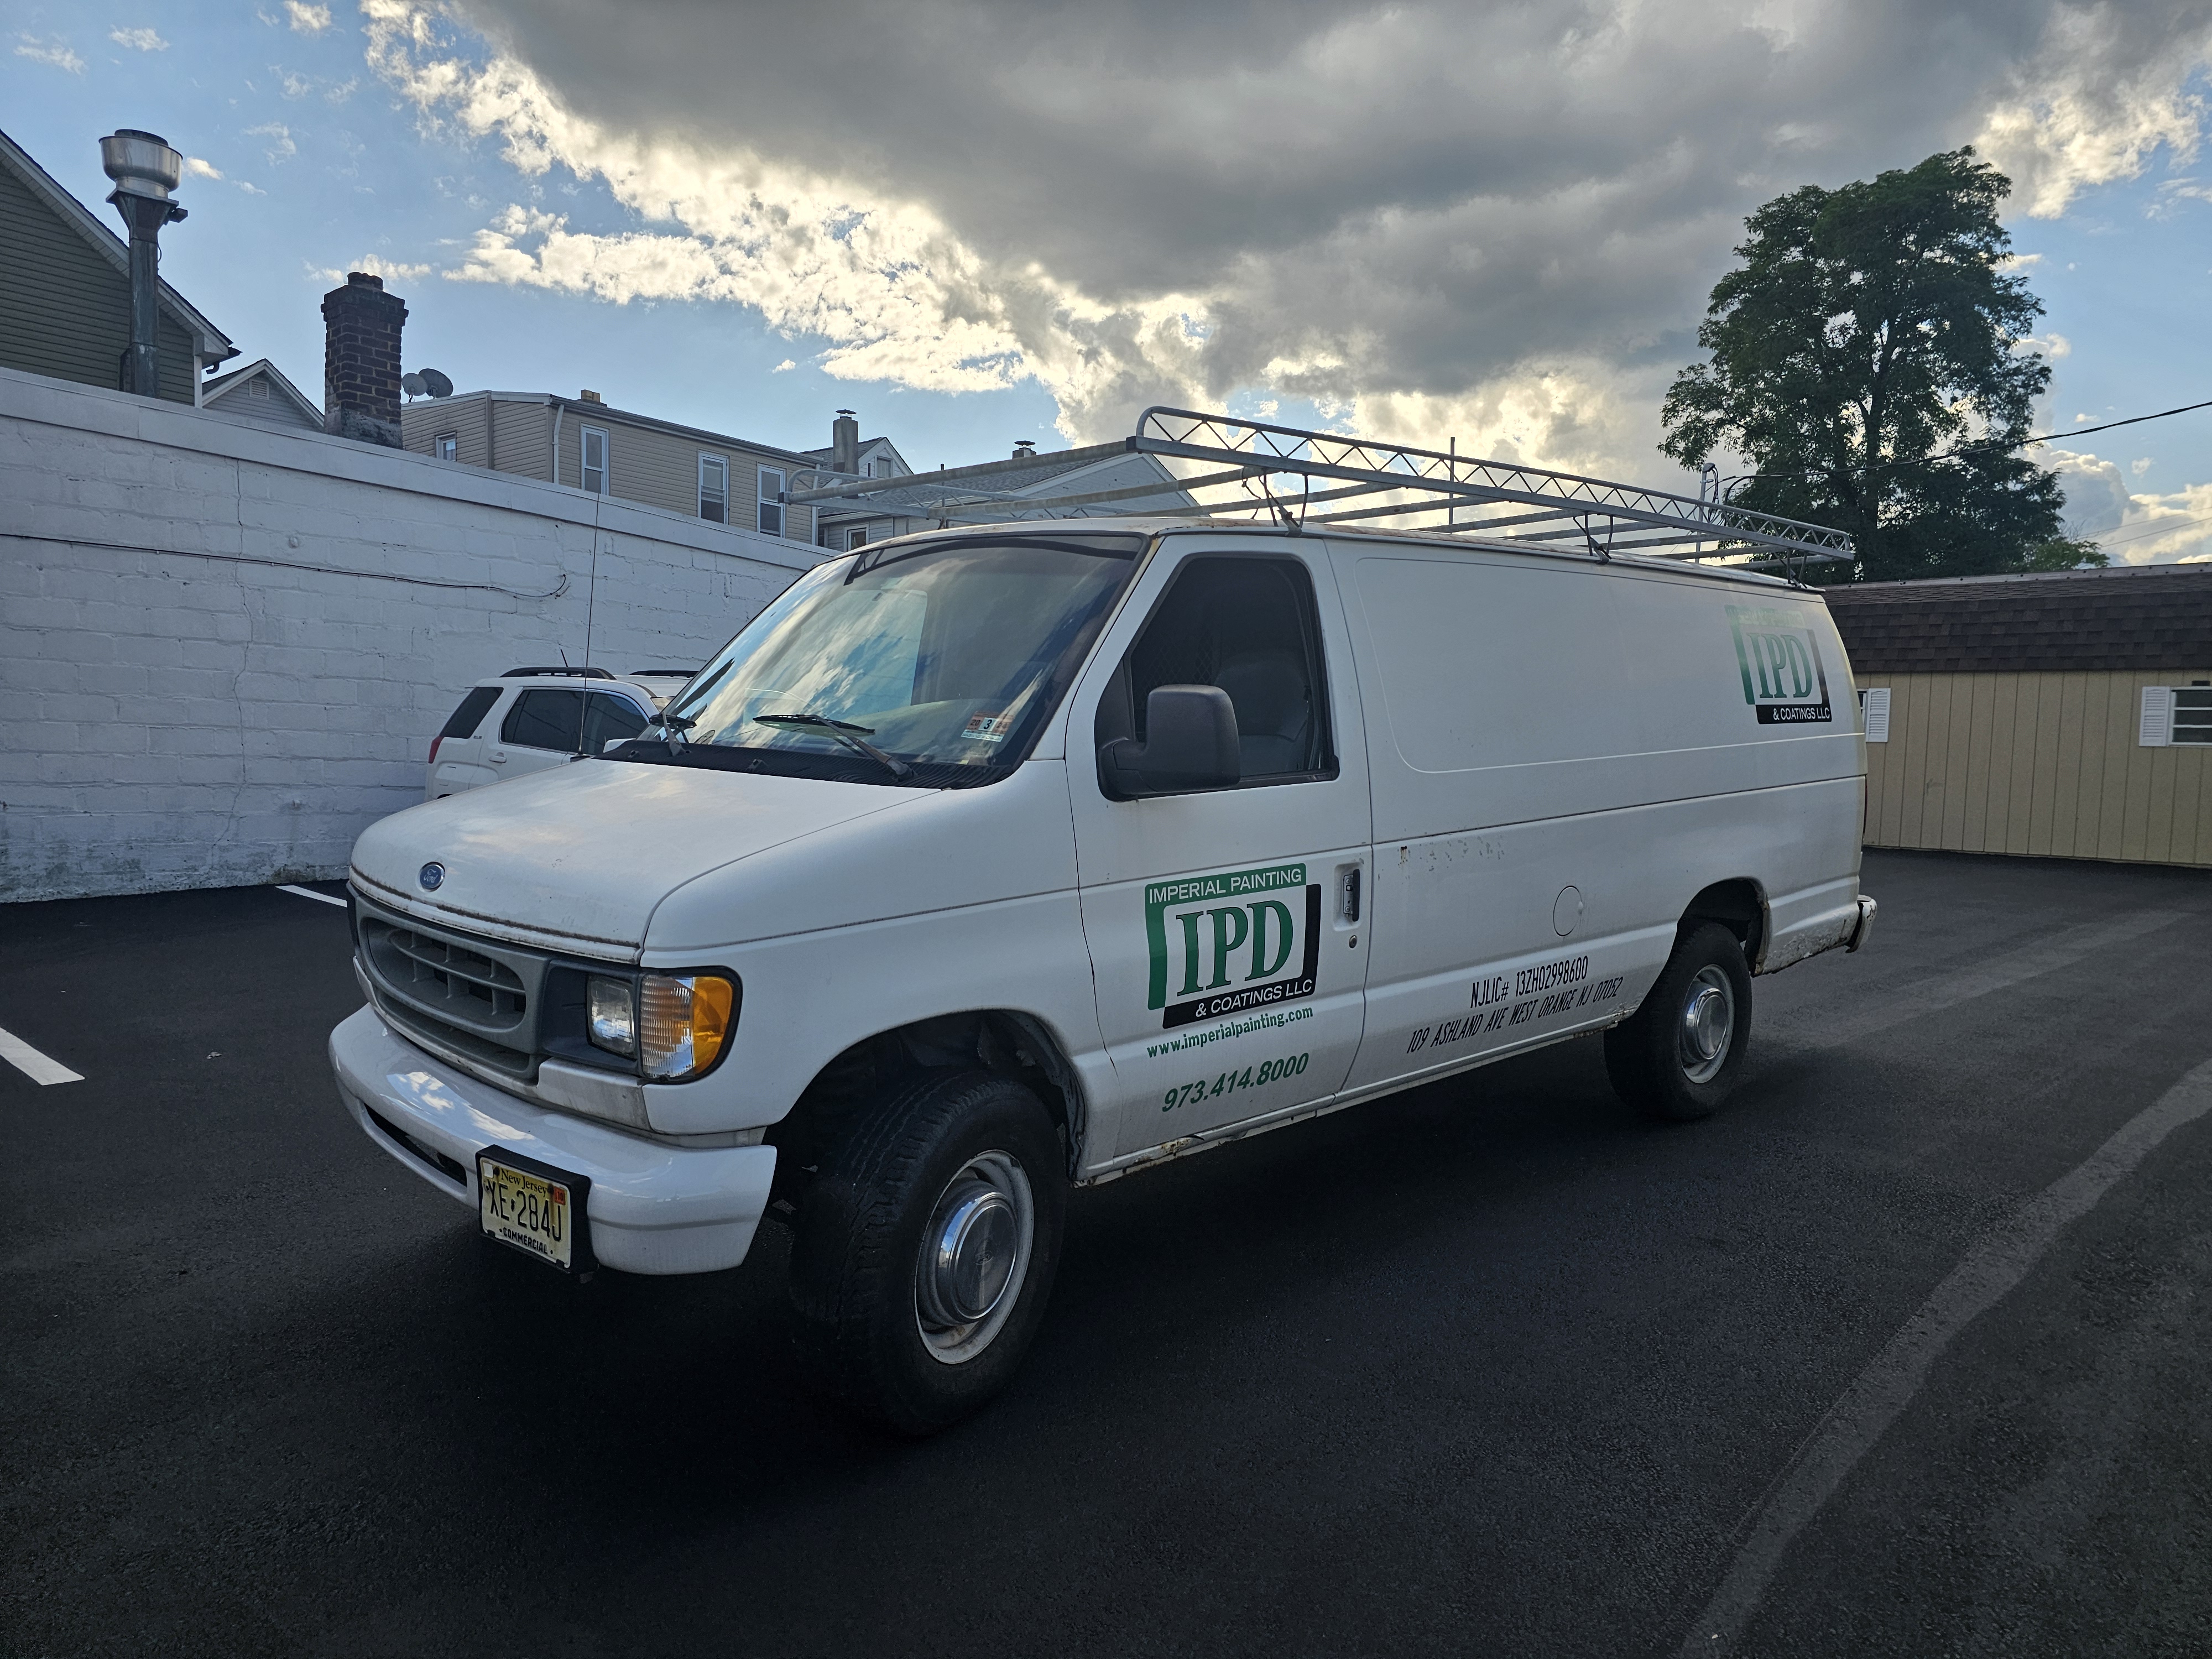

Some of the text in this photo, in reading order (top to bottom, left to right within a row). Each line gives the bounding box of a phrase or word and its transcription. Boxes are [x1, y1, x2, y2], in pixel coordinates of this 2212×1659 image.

[1746, 632, 1813, 698] IPD
[983, 719, 993, 729] 3
[1773, 707, 1830, 721] & COATINGS LLC
[423, 868, 439, 884] Ford
[1149, 868, 1302, 905] IMPERIAL PAINTING
[1175, 900, 1294, 997] IPD
[1195, 978, 1313, 1018] & COATINGS LLC
[1406, 976, 1624, 1054] 109 ASHLAND AVE WEST ORANGE NJ 07052
[1146, 1006, 1314, 1058] www.imperialpainting.com
[1161, 1052, 1310, 1113] 973.414.8000
[501, 1167, 549, 1198] New Jersey
[503, 1227, 549, 1255] COMMERCIAL
